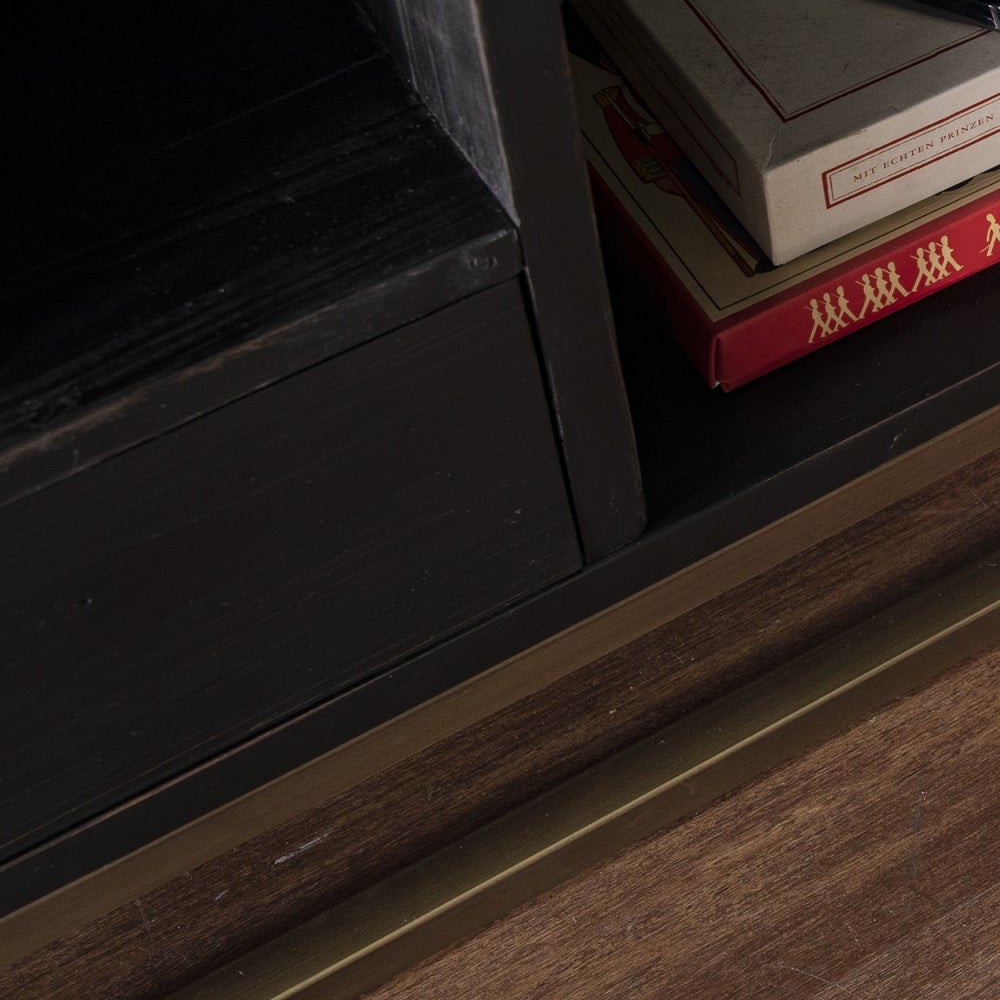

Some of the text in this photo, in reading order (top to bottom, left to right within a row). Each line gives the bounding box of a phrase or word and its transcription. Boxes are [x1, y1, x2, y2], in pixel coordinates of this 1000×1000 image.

[853, 166, 877, 182] MIT
[882, 141, 935, 169] ECHTEN
[940, 113, 995, 144] PRINZEN
